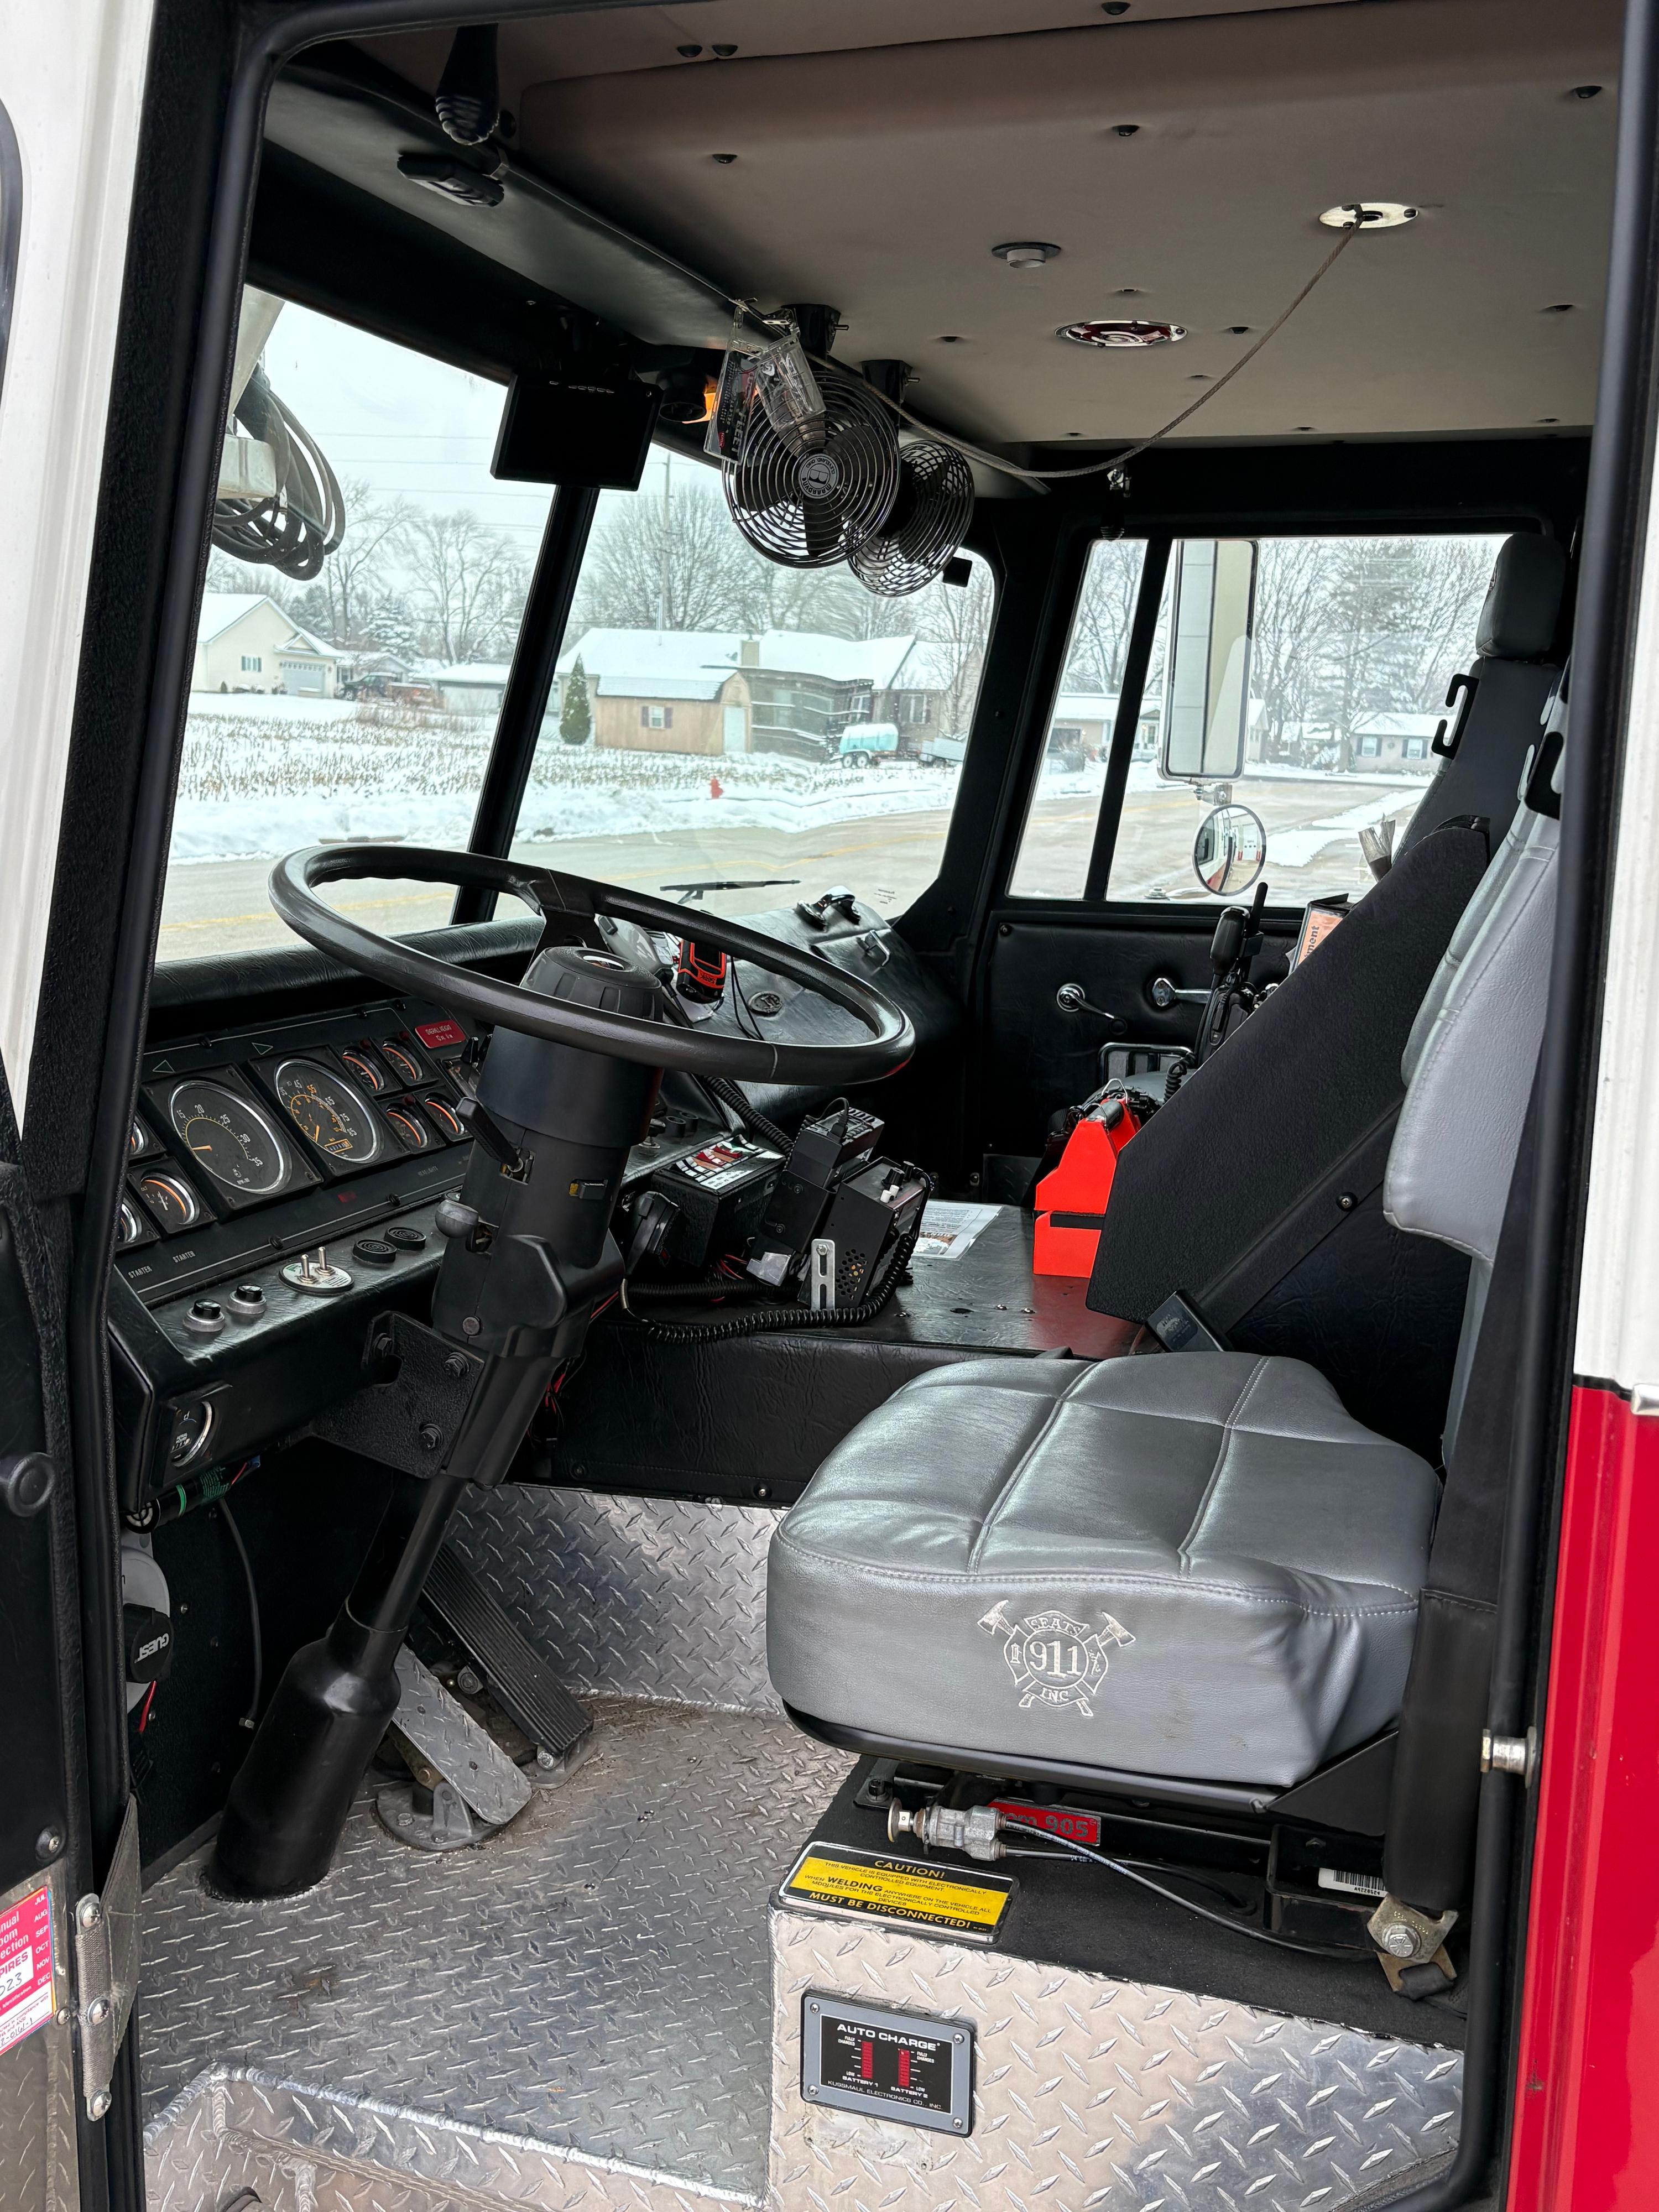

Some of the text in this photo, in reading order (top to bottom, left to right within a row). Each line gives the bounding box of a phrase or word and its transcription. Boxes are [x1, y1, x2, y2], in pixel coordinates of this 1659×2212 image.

[307, 1084, 317, 1094] 55
[325, 1096, 335, 1106] 65
[176, 1109, 186, 1119] 15
[195, 1104, 205, 1114] 20
[221, 1114, 231, 1124] 25
[241, 1134, 251, 1142] 30
[173, 1251, 196, 1263] STARTER
[128, 1265, 153, 1279] STARTER
[1030, 1618, 1081, 1636] SEATS
[137, 1633, 169, 1662] GUEST
[1029, 1640, 1082, 1679] 911
[1040, 1688, 1070, 1704] INC
[1045, 1815, 1088, 1837] 905
[874, 1860, 946, 1879] CAUTION!
[841, 1865, 868, 1873] VEHICLE
[877, 1871, 909, 1881] EQUIPPED
[928, 1881, 987, 1895] ELECTRONICALLY
[860, 1873, 904, 1885] CONTROLLED
[34, 1894, 46, 1905] JUL
[811, 1881, 844, 1890] MODULES
[874, 1892, 932, 1906] ELECTRONICALLY
[934, 1903, 980, 1916] CONTROLLED
[827, 1876, 883, 1892] WELDING
[884, 1890, 921, 1900] ANYWHERE
[950, 1902, 978, 1911] VEHICLE
[878, 1898, 907, 1906] DEVICES
[34, 1909, 48, 1923] AUG
[809, 1892, 971, 1928] MUST BE DISCONNECTED!
[0, 1911, 19, 1934] nual
[35, 1924, 49, 1938] SEP
[35, 1940, 49, 1954] OCT
[36, 1956, 50, 1970] NOV
[38, 1972, 51, 1986] DEC
[837, 2024, 936, 2051] AUTO CHARGE
[842, 2075, 873, 2086] BATTERY
[828, 2080, 865, 2093] KUSSMAUL
[867, 2089, 911, 2103] ELECTRONICS
[890, 2086, 922, 2097] BATTERY
